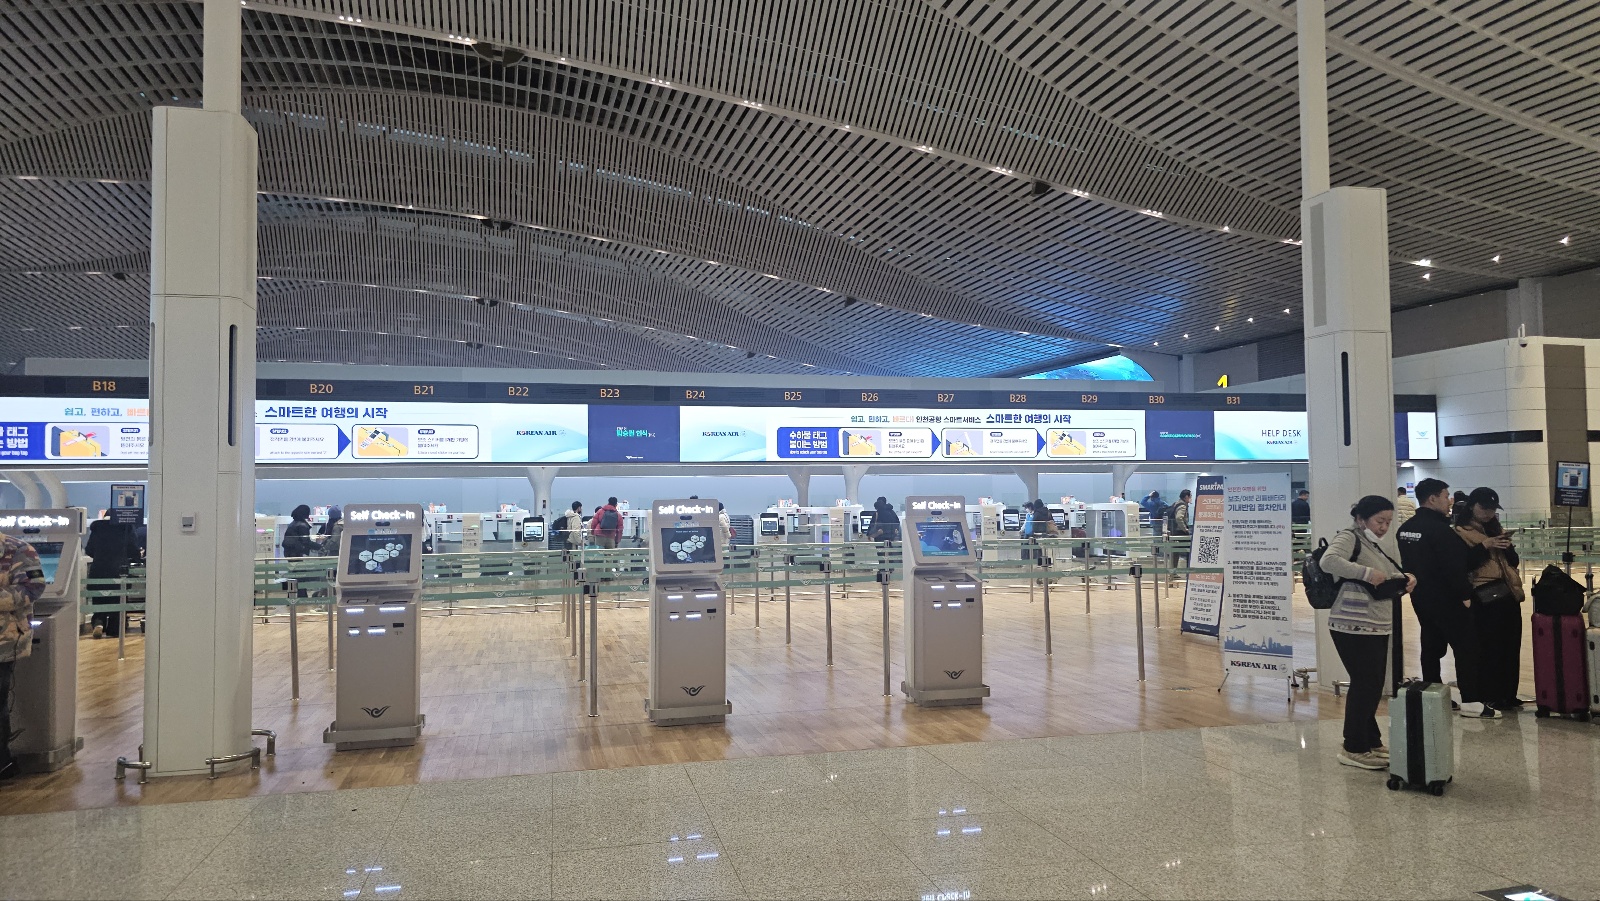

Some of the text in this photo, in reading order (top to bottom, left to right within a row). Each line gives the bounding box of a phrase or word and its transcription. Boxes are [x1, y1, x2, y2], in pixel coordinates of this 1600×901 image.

[92, 381, 116, 391] B18
[310, 384, 333, 394] B20
[414, 385, 434, 395] B21
[508, 386, 529, 396] B22
[600, 388, 620, 398] B23
[686, 390, 705, 399] B24
[784, 391, 802, 400] B25
[861, 393, 878, 402] B26
[937, 394, 954, 403] B27
[1010, 394, 1026, 403] B28
[1081, 395, 1098, 403] B29
[1149, 396, 1164, 404] B30
[1226, 396, 1241, 405] B31
[265, 406, 388, 418] 스마트한 여행의 시작
[986, 414, 1022, 424] 스마트한
[1024, 414, 1051, 424] 여행의
[1054, 414, 1072, 424] 시작
[7, 426, 28, 436] 태그
[812, 430, 828, 440] 태그
[7, 438, 28, 448] 방법
[658, 505, 675, 514] Self
[912, 501, 926, 510] Self
[1228, 503, 1286, 512] 기내반입 절차안내
[350, 510, 370, 520] Self
[0, 516, 16, 527] elf
[1230, 660, 1277, 670] KOREAN AIR
